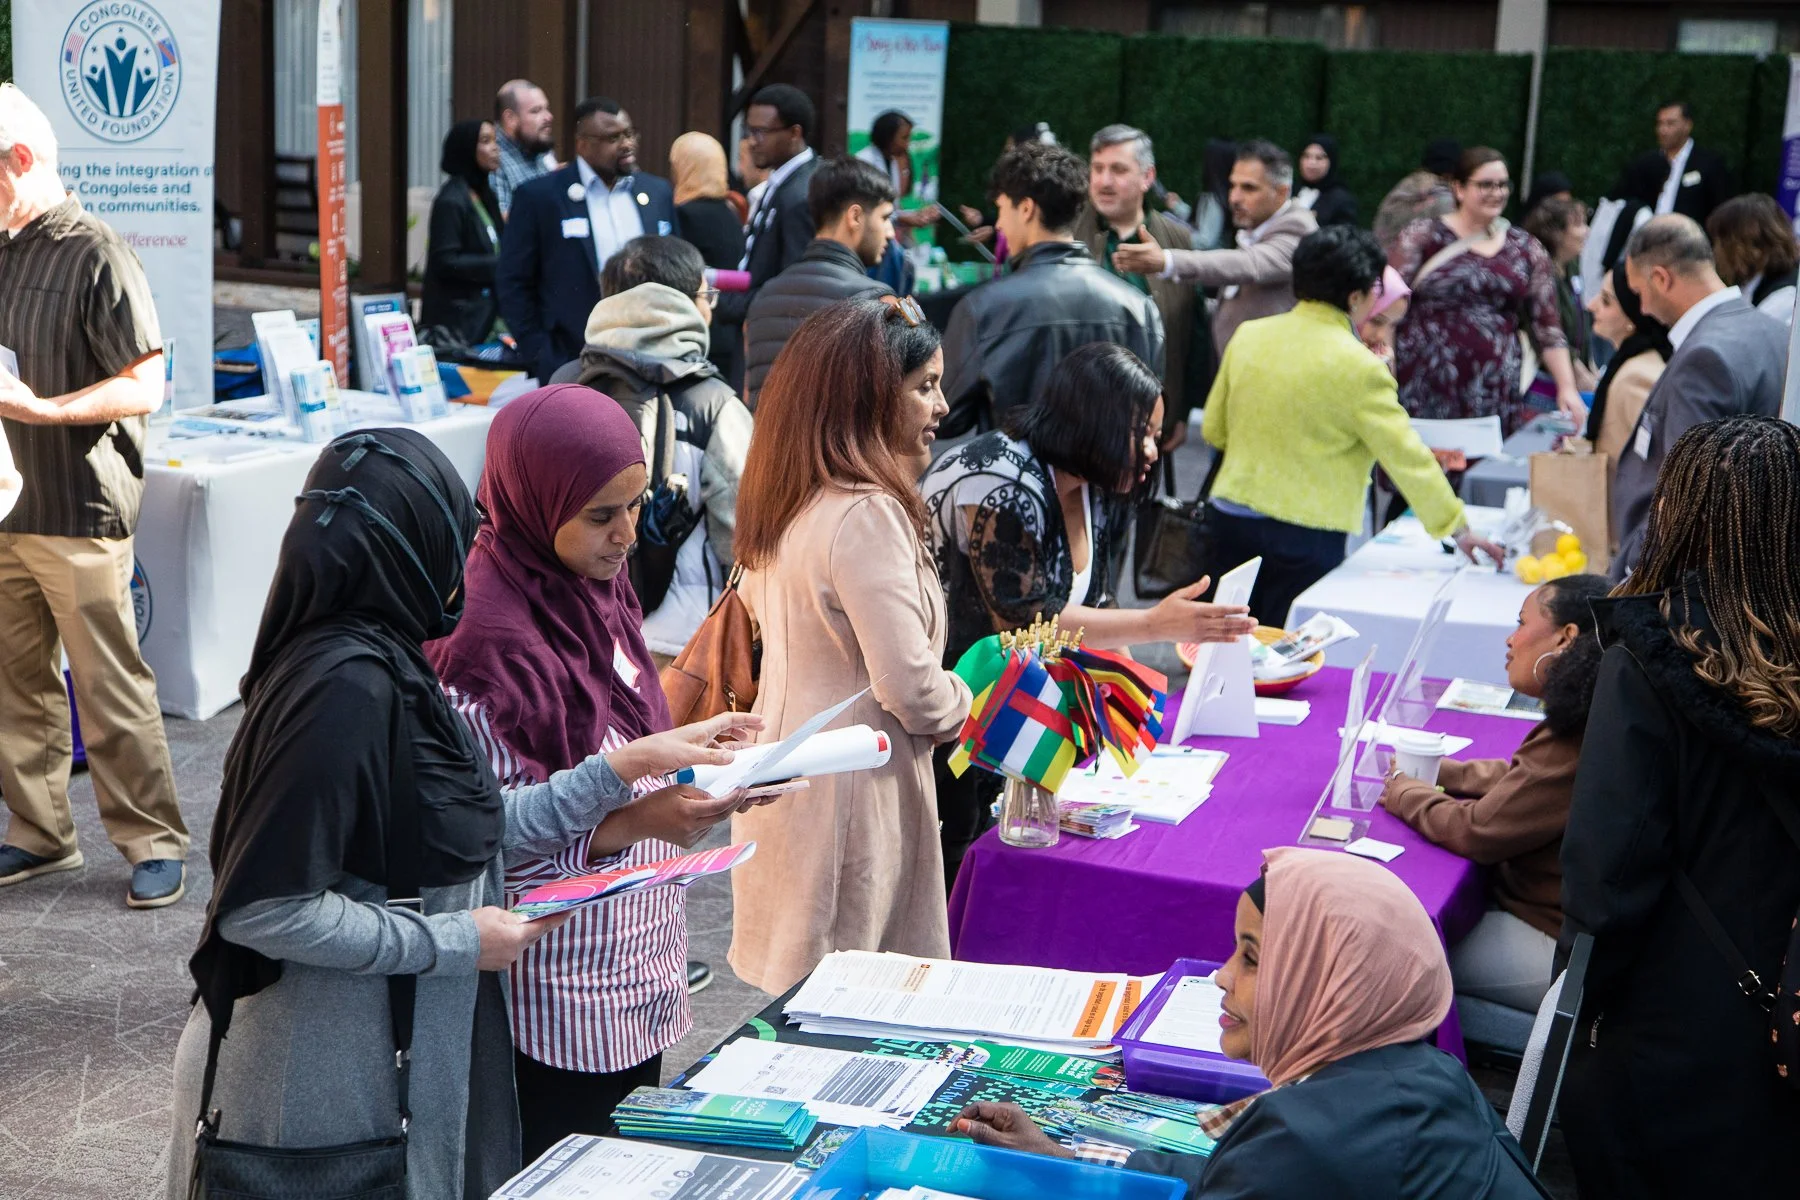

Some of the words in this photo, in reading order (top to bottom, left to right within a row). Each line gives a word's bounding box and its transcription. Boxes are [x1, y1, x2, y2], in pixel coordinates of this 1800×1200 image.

[80, 3, 161, 34] CONGOLESE
[66, 69, 98, 124] UNITED
[101, 71, 174, 135] FOUNDATION
[86, 163, 111, 176] the
[116, 162, 198, 178] integration
[79, 181, 157, 197] Congolese
[162, 182, 191, 194] and
[98, 200, 201, 212] communities.
[122, 231, 188, 247] ifference
[937, 1072, 978, 1103] r.ioi.tw
